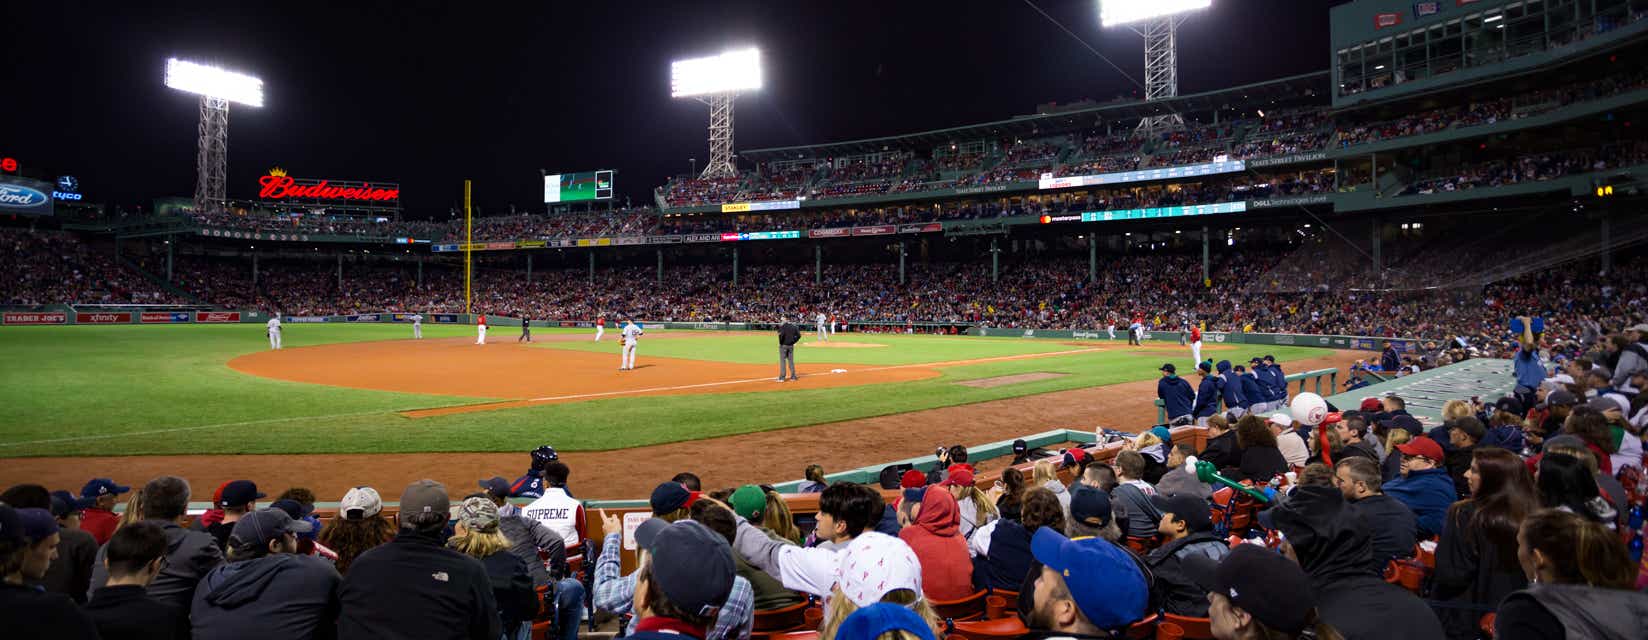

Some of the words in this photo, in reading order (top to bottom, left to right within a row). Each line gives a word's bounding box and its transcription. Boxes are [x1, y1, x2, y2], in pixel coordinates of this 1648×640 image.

[259, 176, 399, 201] Budweiser
[52, 191, 82, 200] tyco
[527, 508, 569, 520] SUPREME
